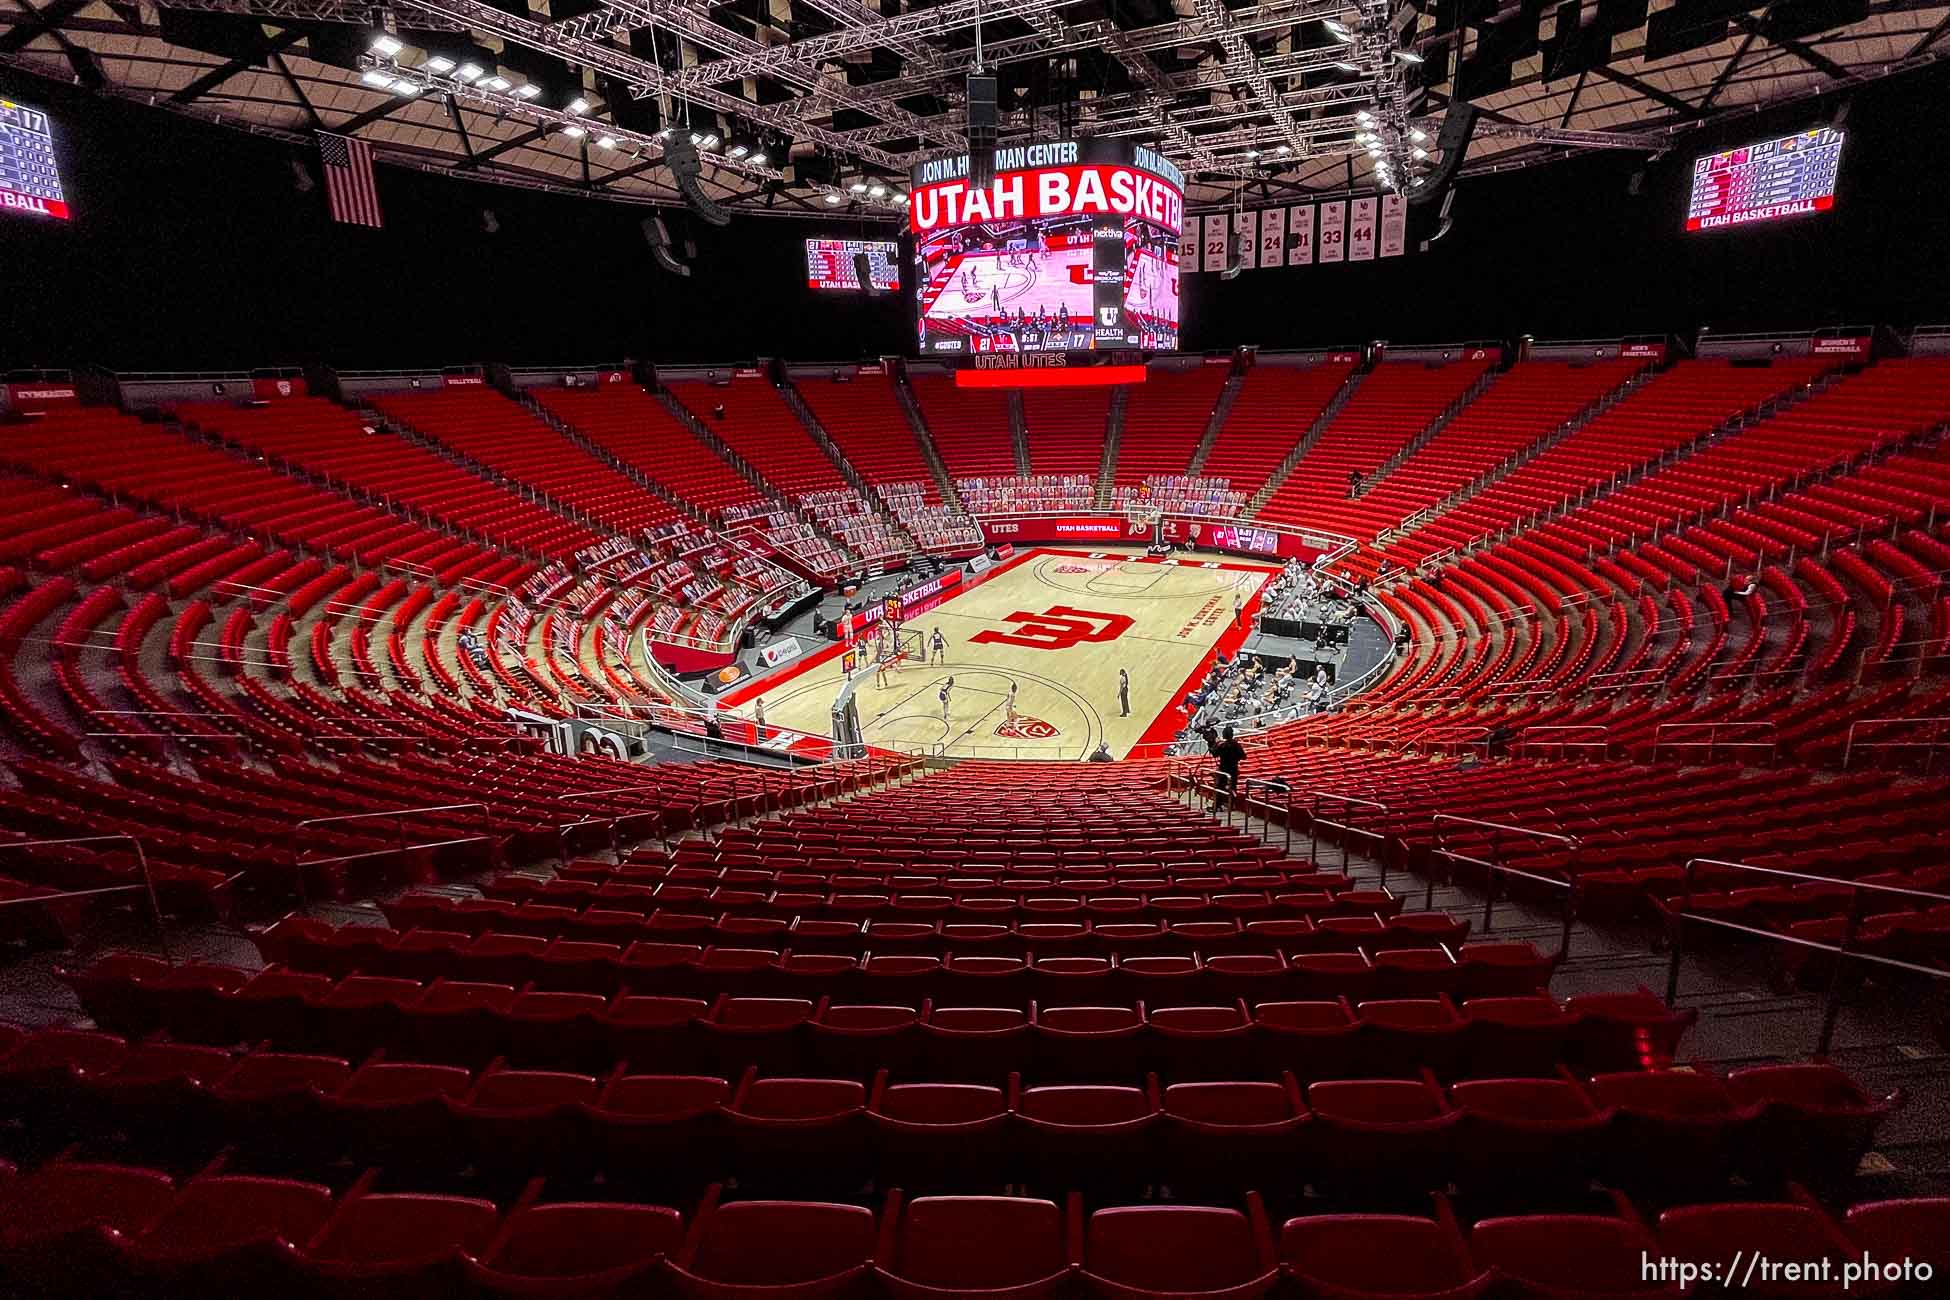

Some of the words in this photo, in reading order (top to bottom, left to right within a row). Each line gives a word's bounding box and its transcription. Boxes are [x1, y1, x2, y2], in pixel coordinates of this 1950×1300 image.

[23, 110, 42, 130] 17
[922, 160, 943, 182] JON
[943, 158, 957, 178] M.
[1027, 141, 1078, 166] CENTER
[1697, 159, 1713, 174] 21
[0, 190, 50, 213] BALL
[915, 176, 1024, 229] UTAH
[1701, 213, 1731, 228] UTAH
[1733, 200, 1816, 224] BASKETBALL
[1094, 226, 1123, 238] nextiva
[1323, 230, 1342, 244] 33
[1354, 227, 1372, 241] 44
[1181, 243, 1195, 256] 15
[1208, 241, 1224, 255] 22
[1264, 236, 1281, 250] 24
[820, 280, 840, 288] UTAH
[1095, 328, 1124, 337] HEALTH
[1074, 335, 1085, 347] 17
[975, 354, 1019, 369] UTAH
[1022, 352, 1067, 367] UTES
[991, 523, 1019, 534] UTES
[865, 603, 885, 622] UTA
